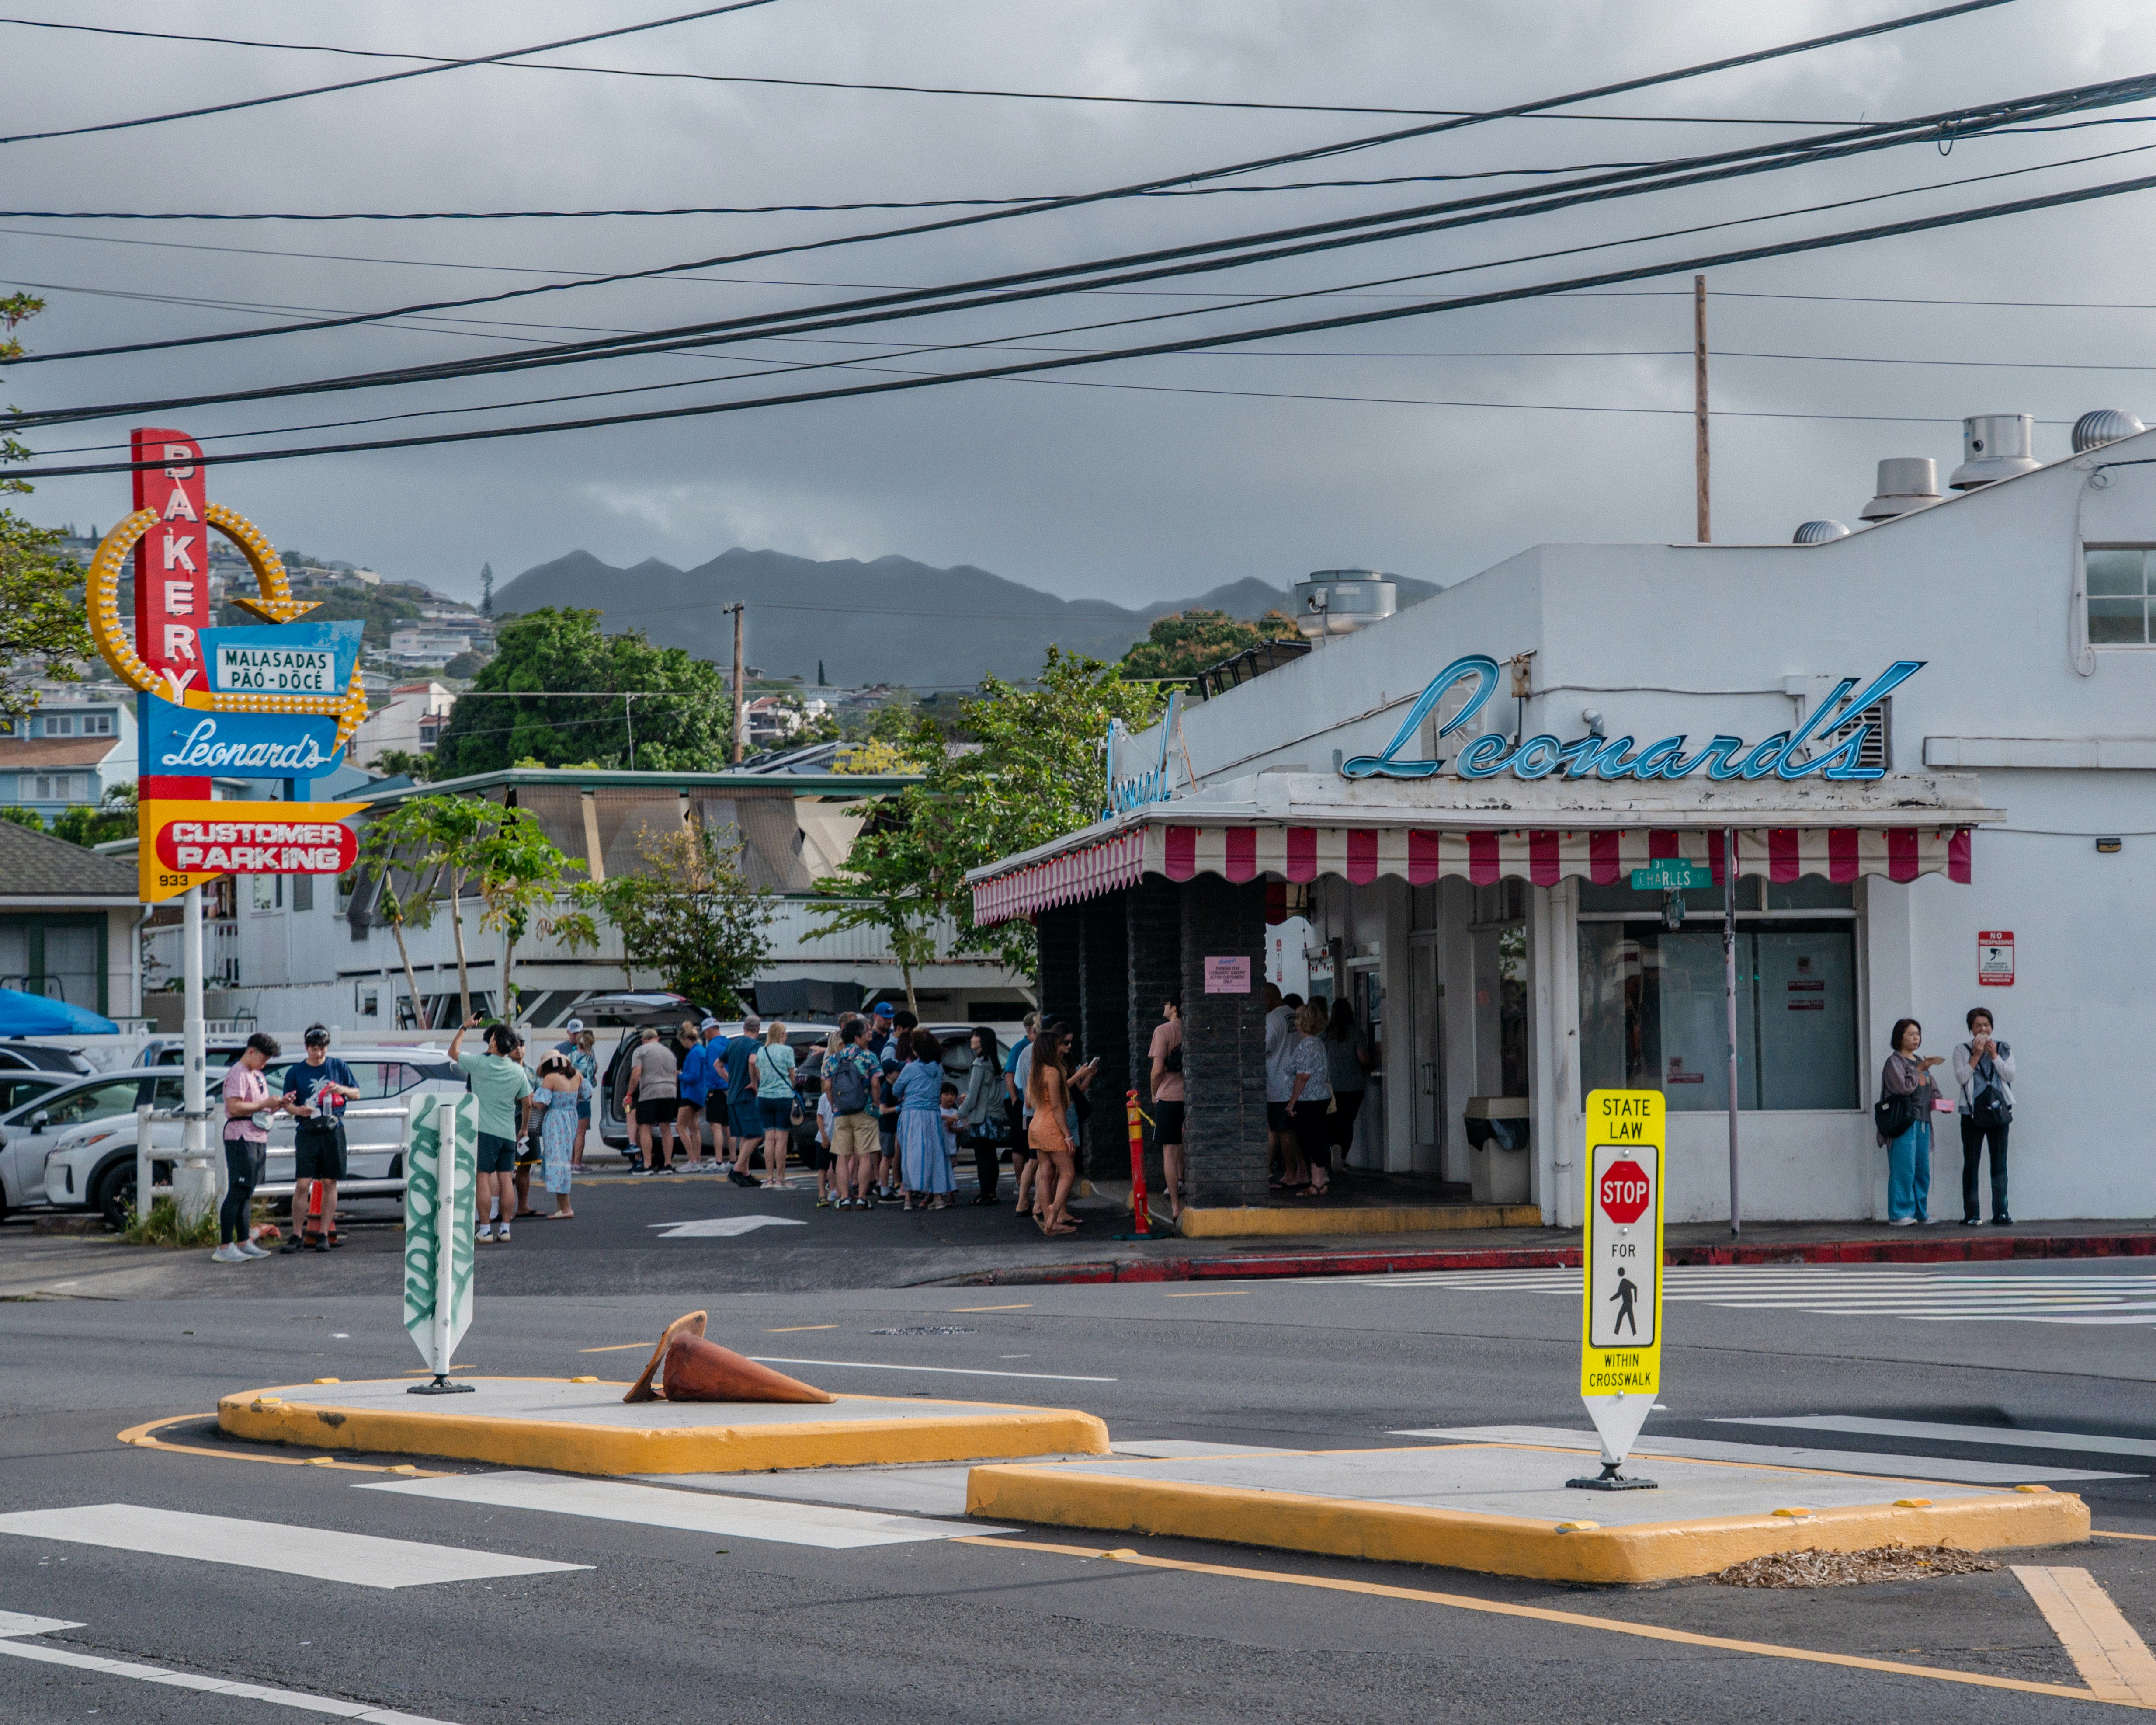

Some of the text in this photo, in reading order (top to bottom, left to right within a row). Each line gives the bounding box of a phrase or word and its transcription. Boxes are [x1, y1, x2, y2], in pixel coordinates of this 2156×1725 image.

[162, 444, 198, 706] BAKERY
[226, 650, 326, 669] MALASADAS
[1341, 654, 1927, 780] Leonard's
[162, 718, 328, 769] Leonard's
[172, 823, 342, 845] CUSTOMER
[177, 846, 340, 869] PARKING
[159, 875, 188, 886] 933
[1639, 871, 1691, 887] CHARLES
[1603, 1099, 1651, 1116] STATE
[1610, 1122, 1642, 1139] LAW
[1603, 1180, 1647, 1204] STOP
[1611, 1244, 1635, 1257] FOR
[1604, 1353, 1639, 1367] WITHIN
[1590, 1372, 1651, 1387] CROSSWALK
